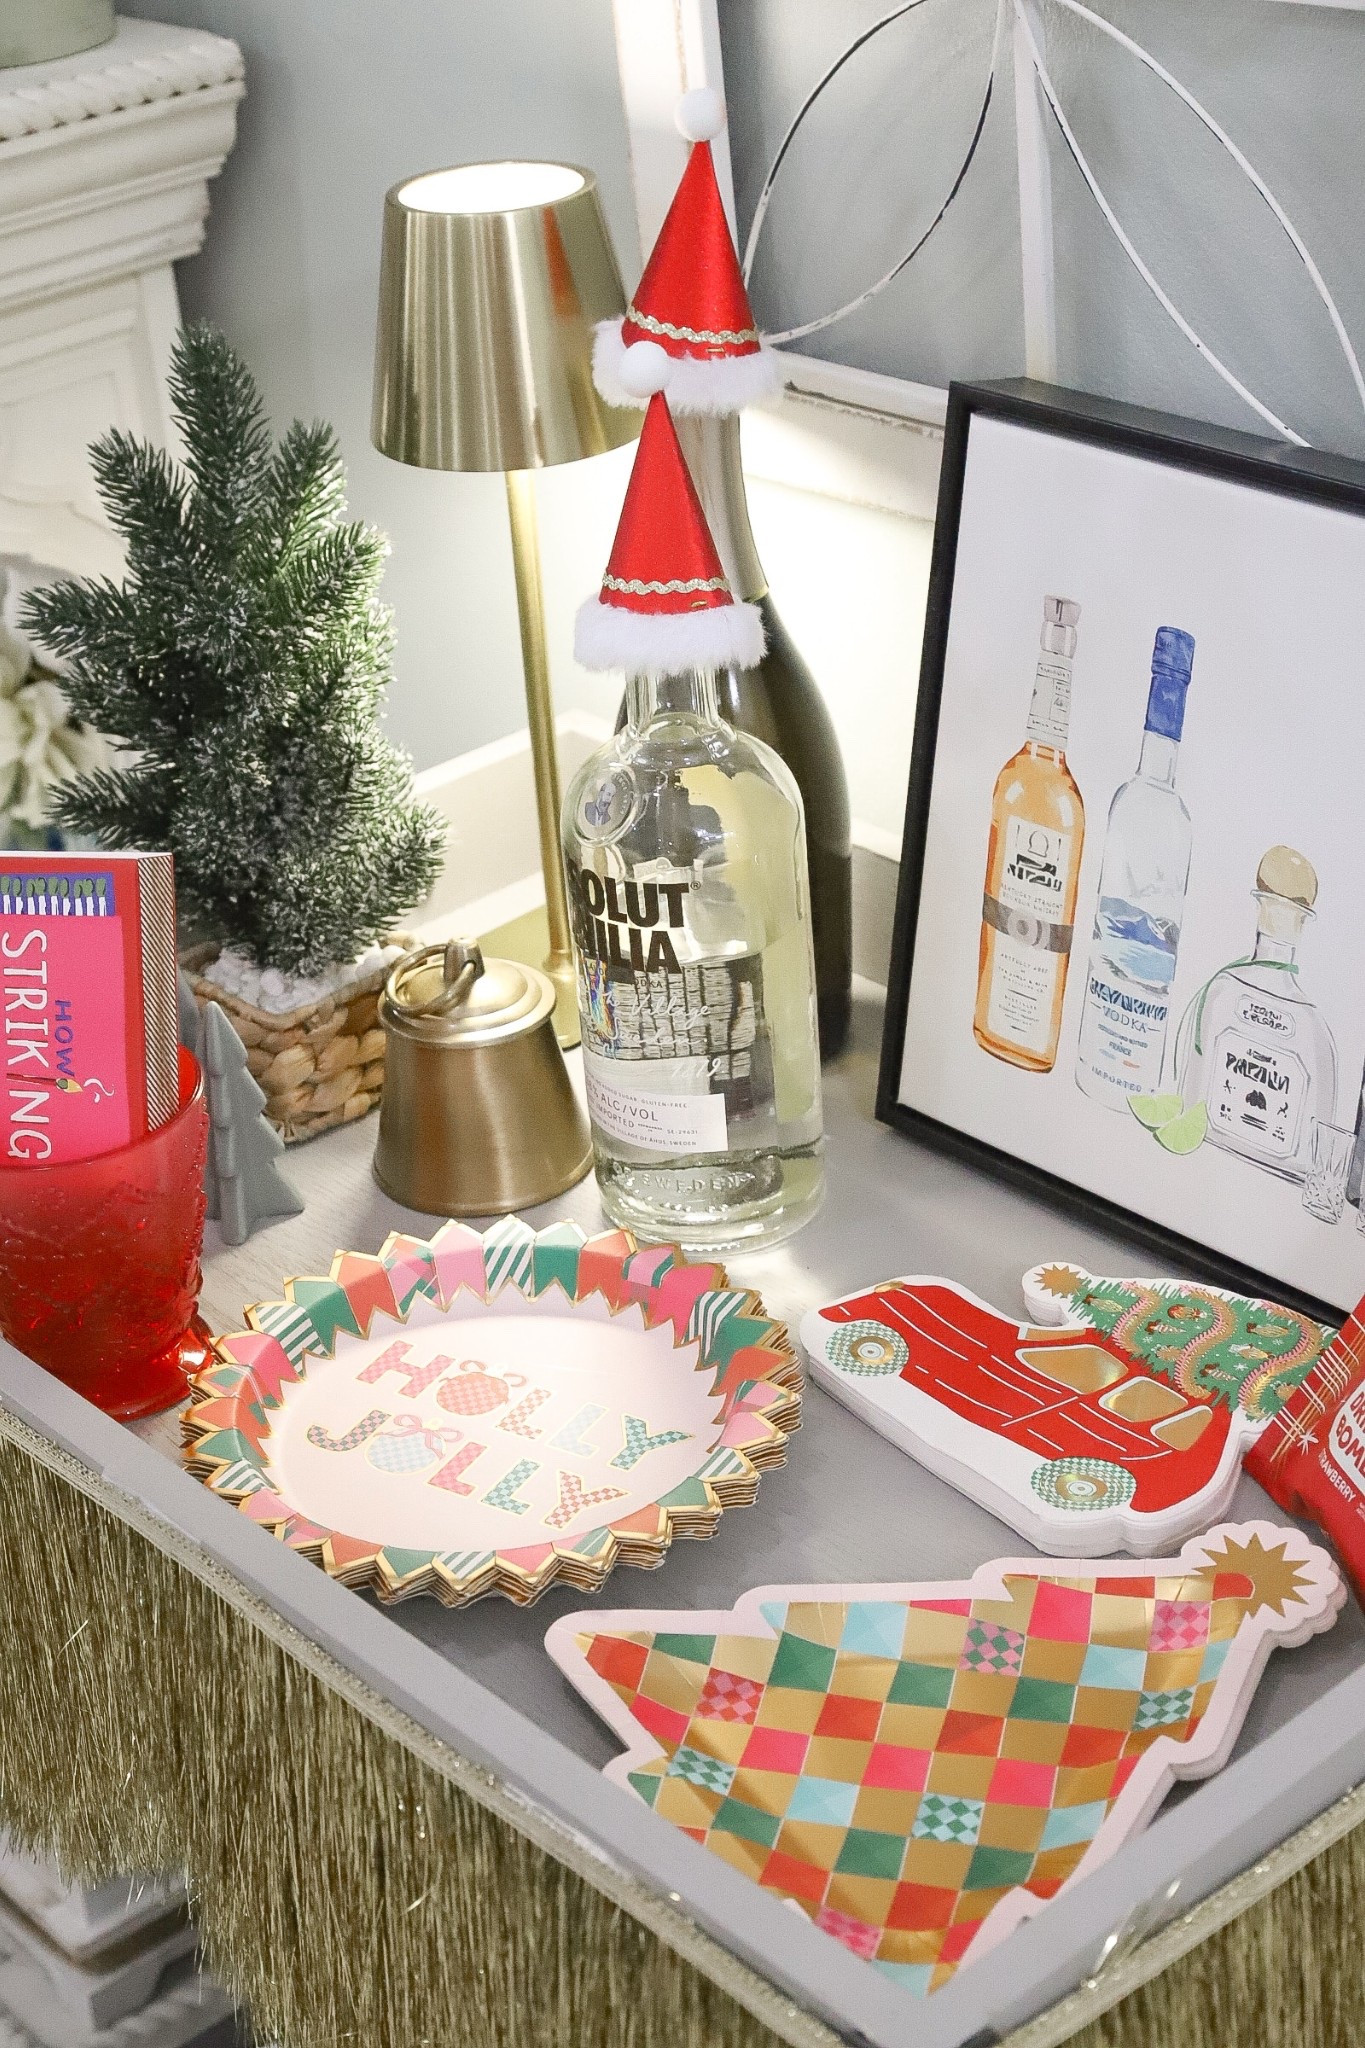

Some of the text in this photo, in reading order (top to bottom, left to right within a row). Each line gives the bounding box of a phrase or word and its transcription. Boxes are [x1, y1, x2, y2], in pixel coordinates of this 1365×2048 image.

[54, 999, 75, 1077] HOW
[1103, 1005, 1147, 1033] VODKA
[1091, 1065, 1142, 1093] IMPORTED
[600, 1092, 659, 1122] ALC/VOL
[354, 1339, 696, 1472] HOLLY
[305, 1408, 631, 1530] JOLLY
